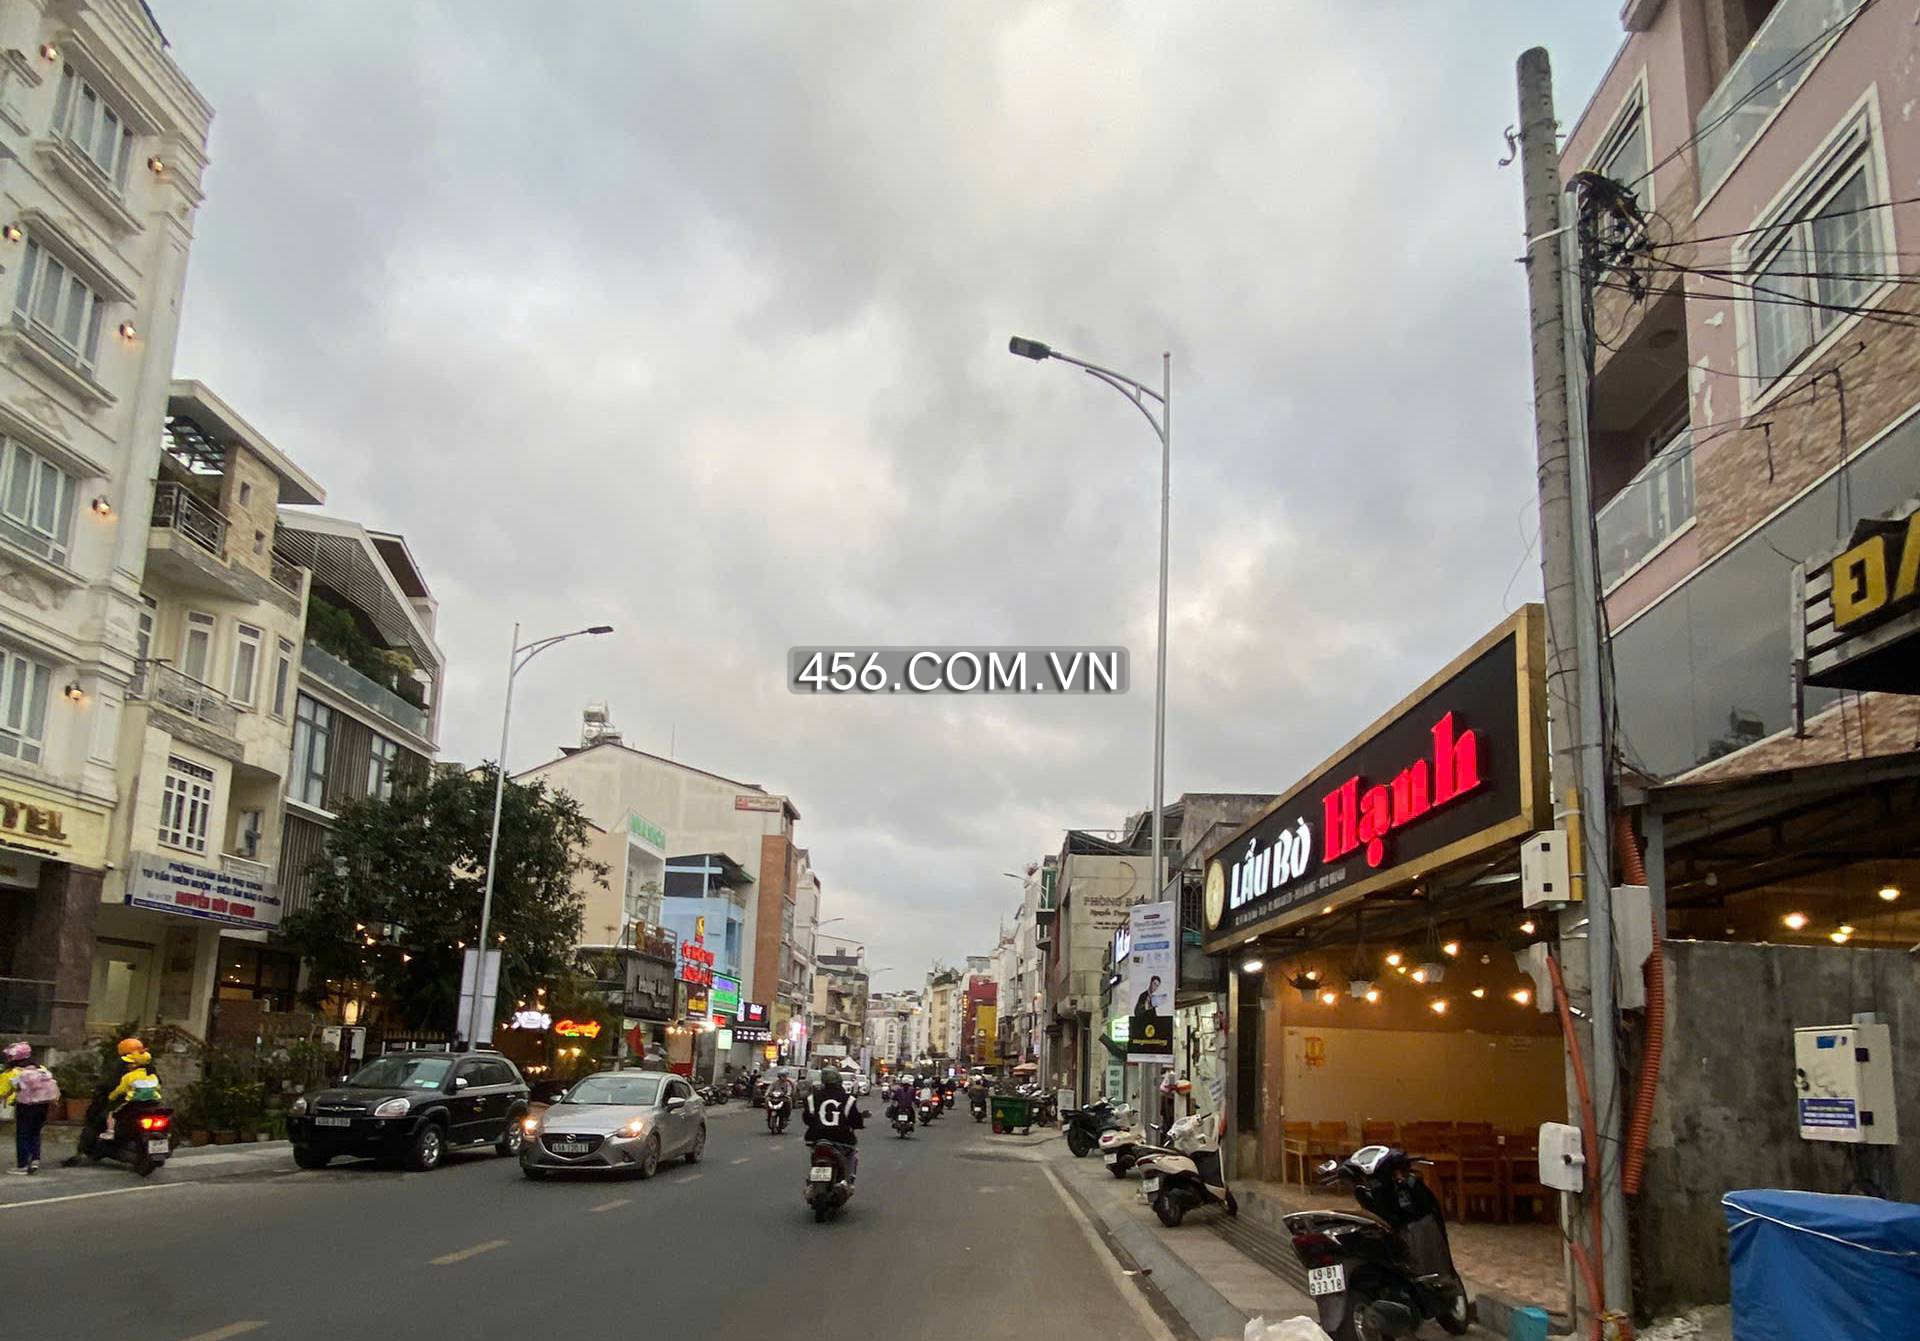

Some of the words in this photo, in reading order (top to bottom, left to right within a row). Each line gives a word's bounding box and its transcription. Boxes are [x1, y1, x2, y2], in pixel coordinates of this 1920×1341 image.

[1230, 838, 1272, 910] LẨU
[1272, 816, 1311, 889] BÒ
[1322, 711, 1481, 868] Hạnh
[818, 1099, 842, 1126] G
